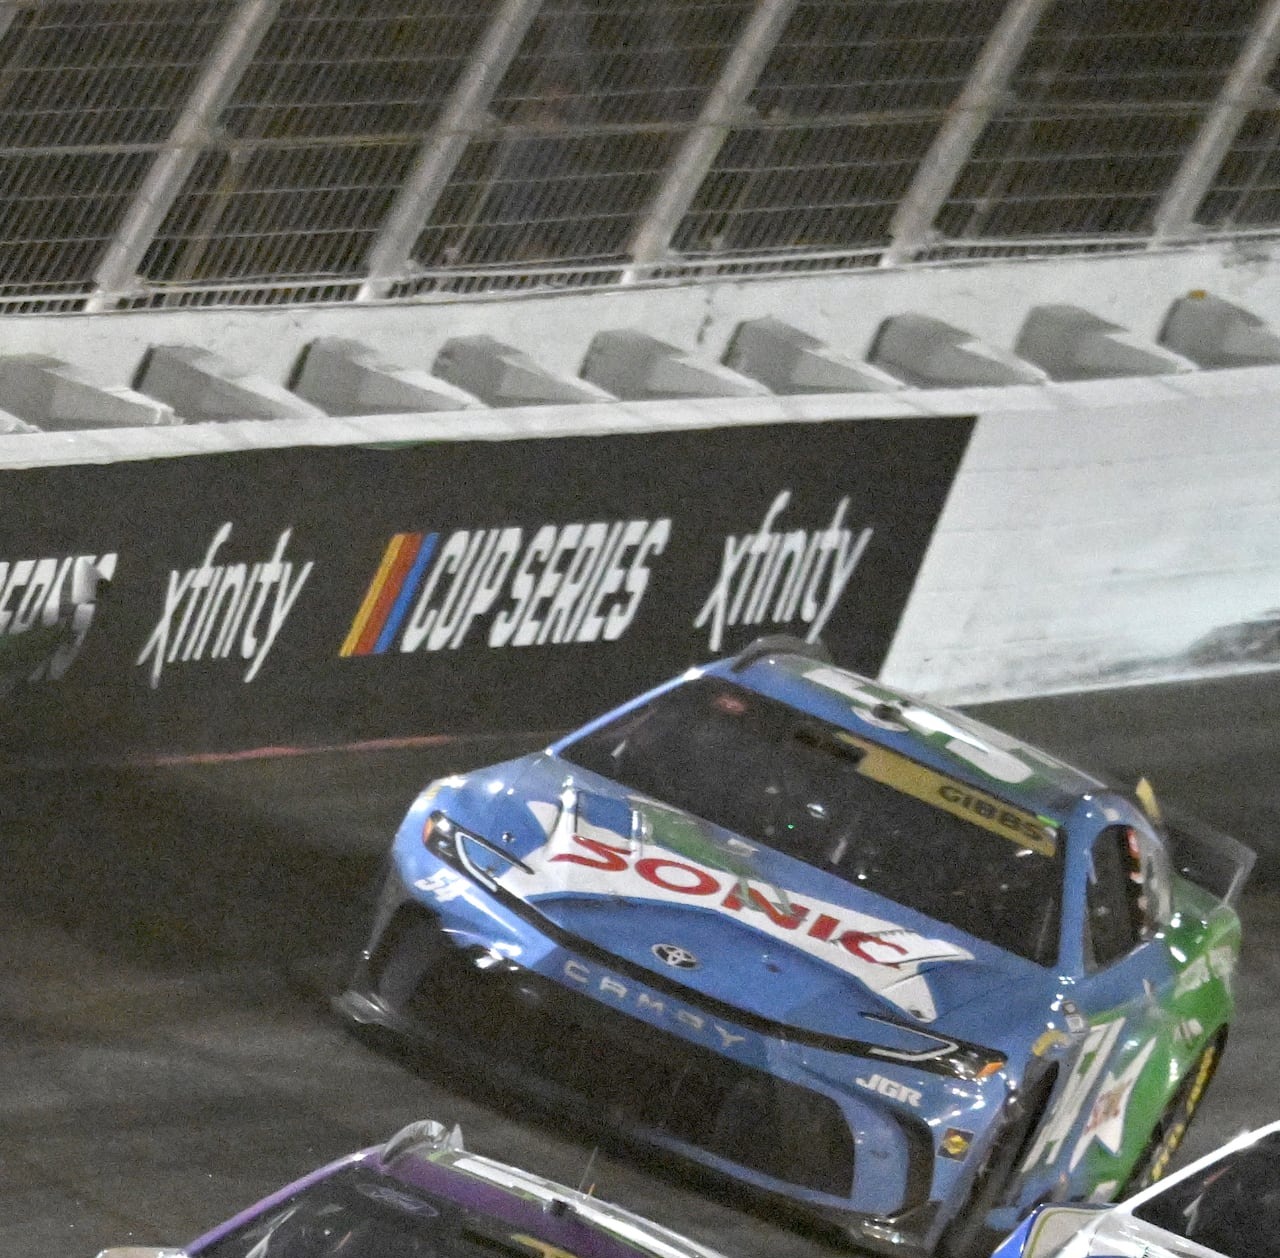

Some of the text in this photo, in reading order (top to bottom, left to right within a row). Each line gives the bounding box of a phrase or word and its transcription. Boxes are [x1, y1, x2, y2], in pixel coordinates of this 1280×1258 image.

[136, 522, 313, 689] xfinity
[400, 519, 672, 654] CUP SERIES
[693, 491, 874, 652] xfinity
[939, 784, 1046, 843] GIBBS
[547, 834, 908, 971] SONIC
[563, 959, 745, 1048] CAMRY
[855, 1074, 922, 1107] JGR
